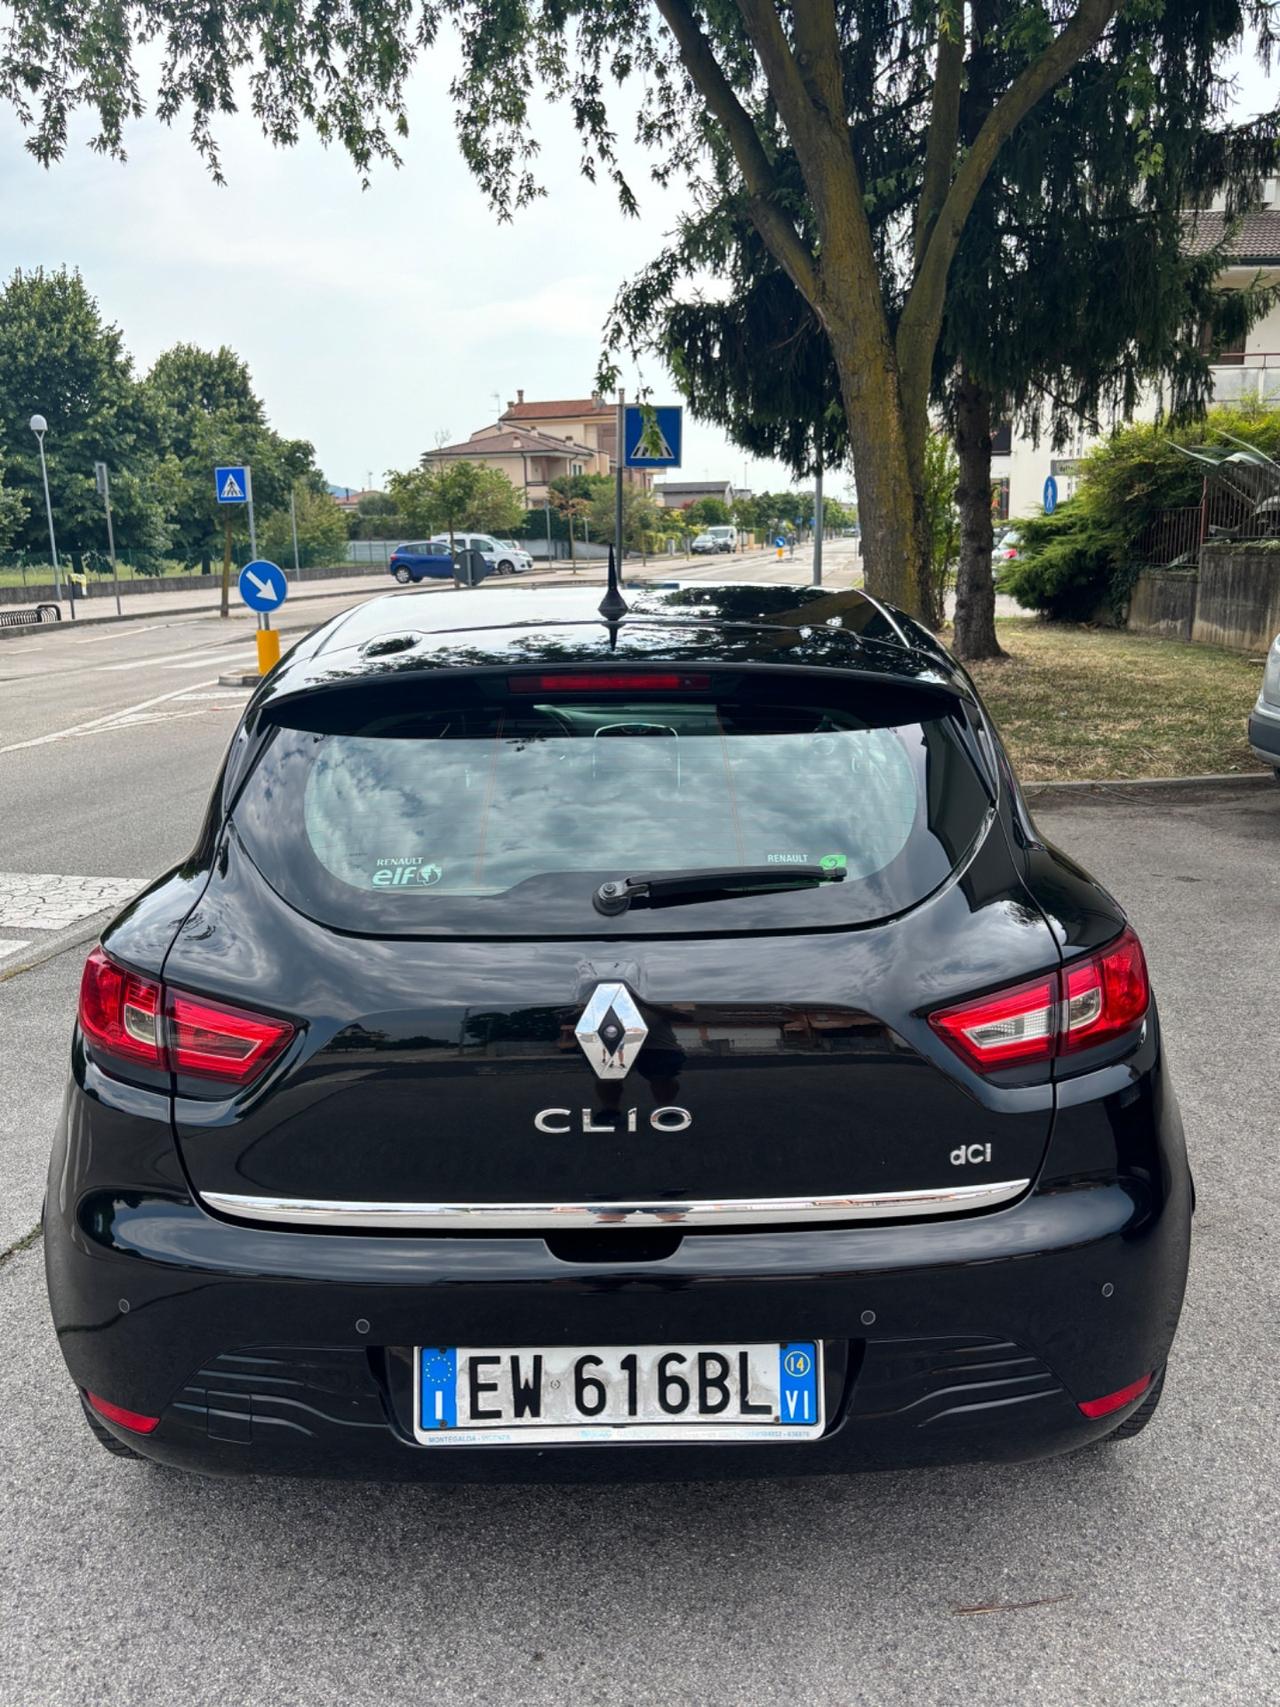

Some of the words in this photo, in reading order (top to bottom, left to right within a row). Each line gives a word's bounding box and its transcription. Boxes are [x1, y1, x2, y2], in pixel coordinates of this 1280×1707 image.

[376, 857, 424, 866] RENAULT
[767, 854, 809, 863] RENAULT
[372, 866, 417, 886] elf
[534, 1106, 692, 1134] CLIO
[788, 1357, 805, 1372] 14
[469, 1354, 543, 1420] EW
[574, 1351, 773, 1417] 616BL
[435, 1390, 443, 1420] I
[785, 1390, 810, 1420] VI
